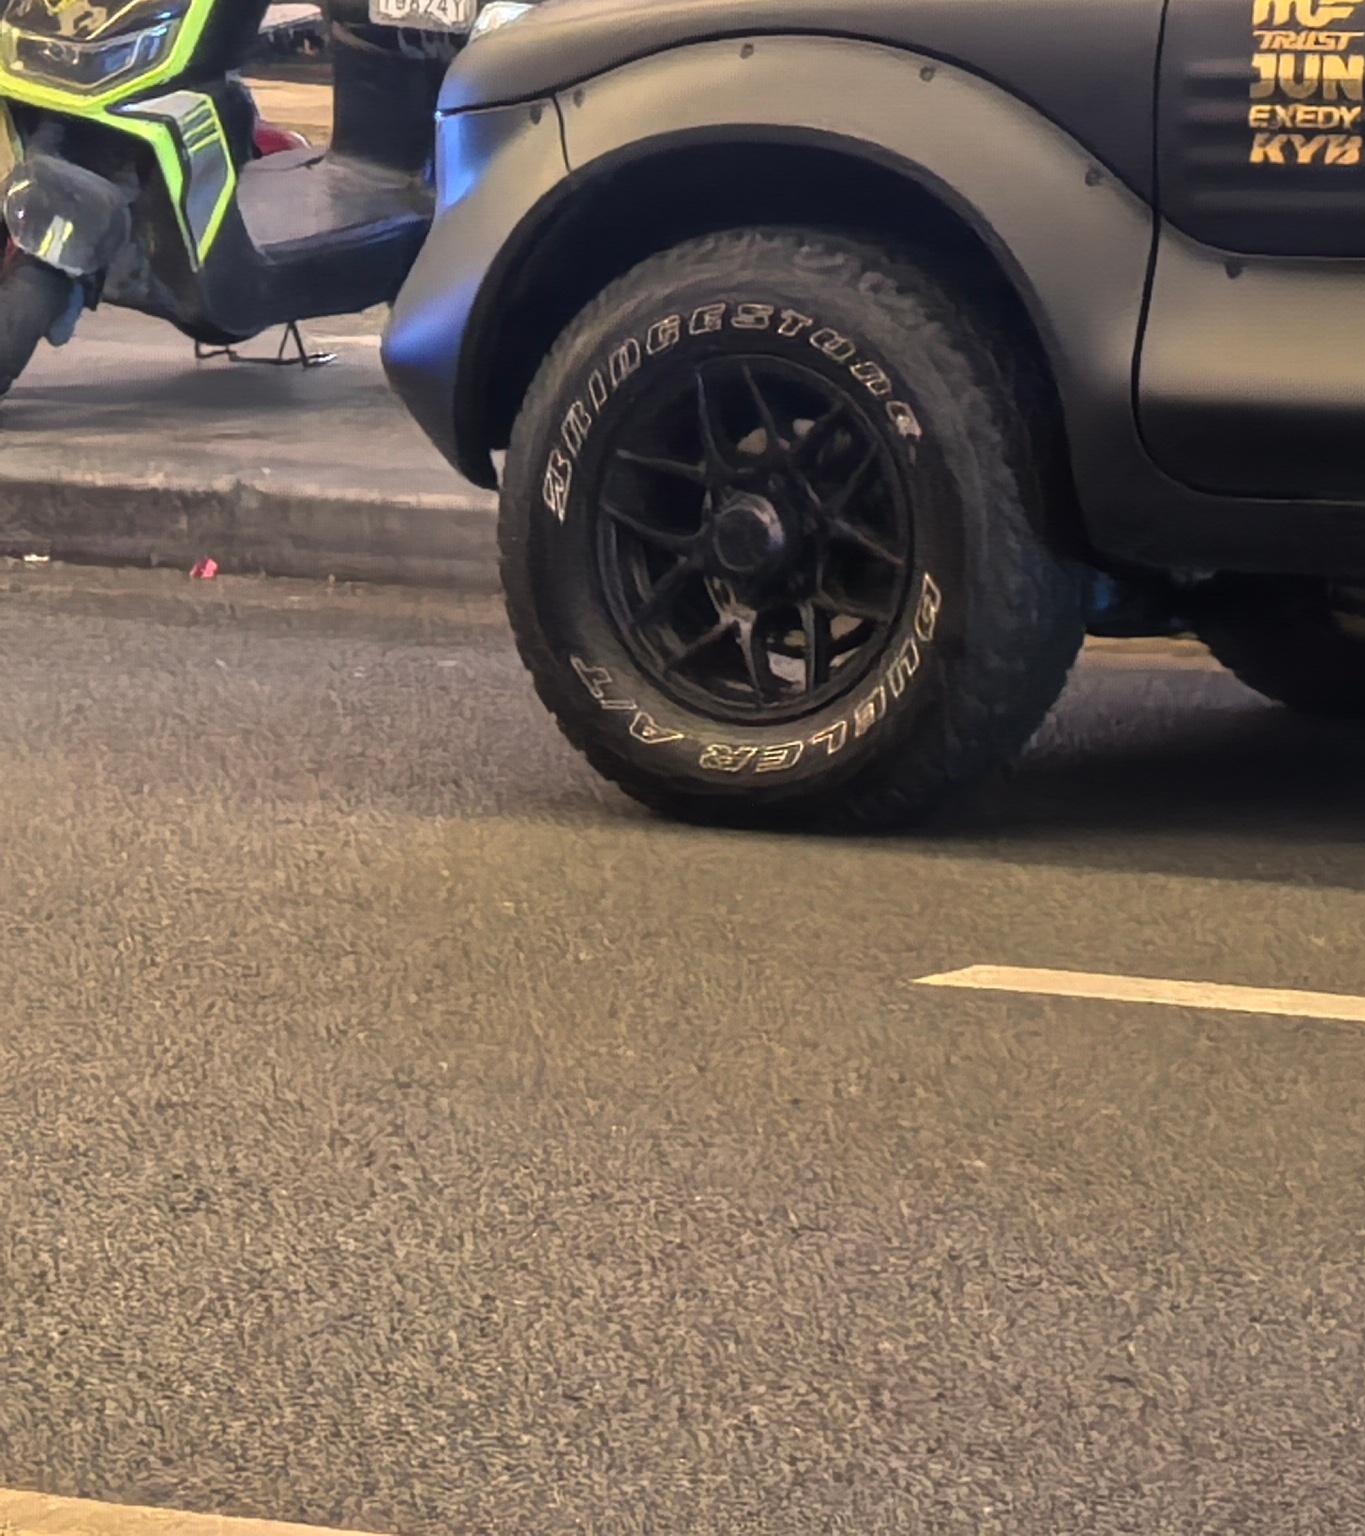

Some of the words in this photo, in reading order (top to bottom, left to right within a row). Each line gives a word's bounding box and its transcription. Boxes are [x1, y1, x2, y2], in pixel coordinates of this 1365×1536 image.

[1248, 52, 1365, 102] JUN
[1248, 103, 1362, 129] EXEDY
[1248, 132, 1365, 166] KYB
[542, 300, 924, 525] BRIDGESTONE
[569, 652, 686, 747] A/T
[698, 571, 943, 775] DUELER
